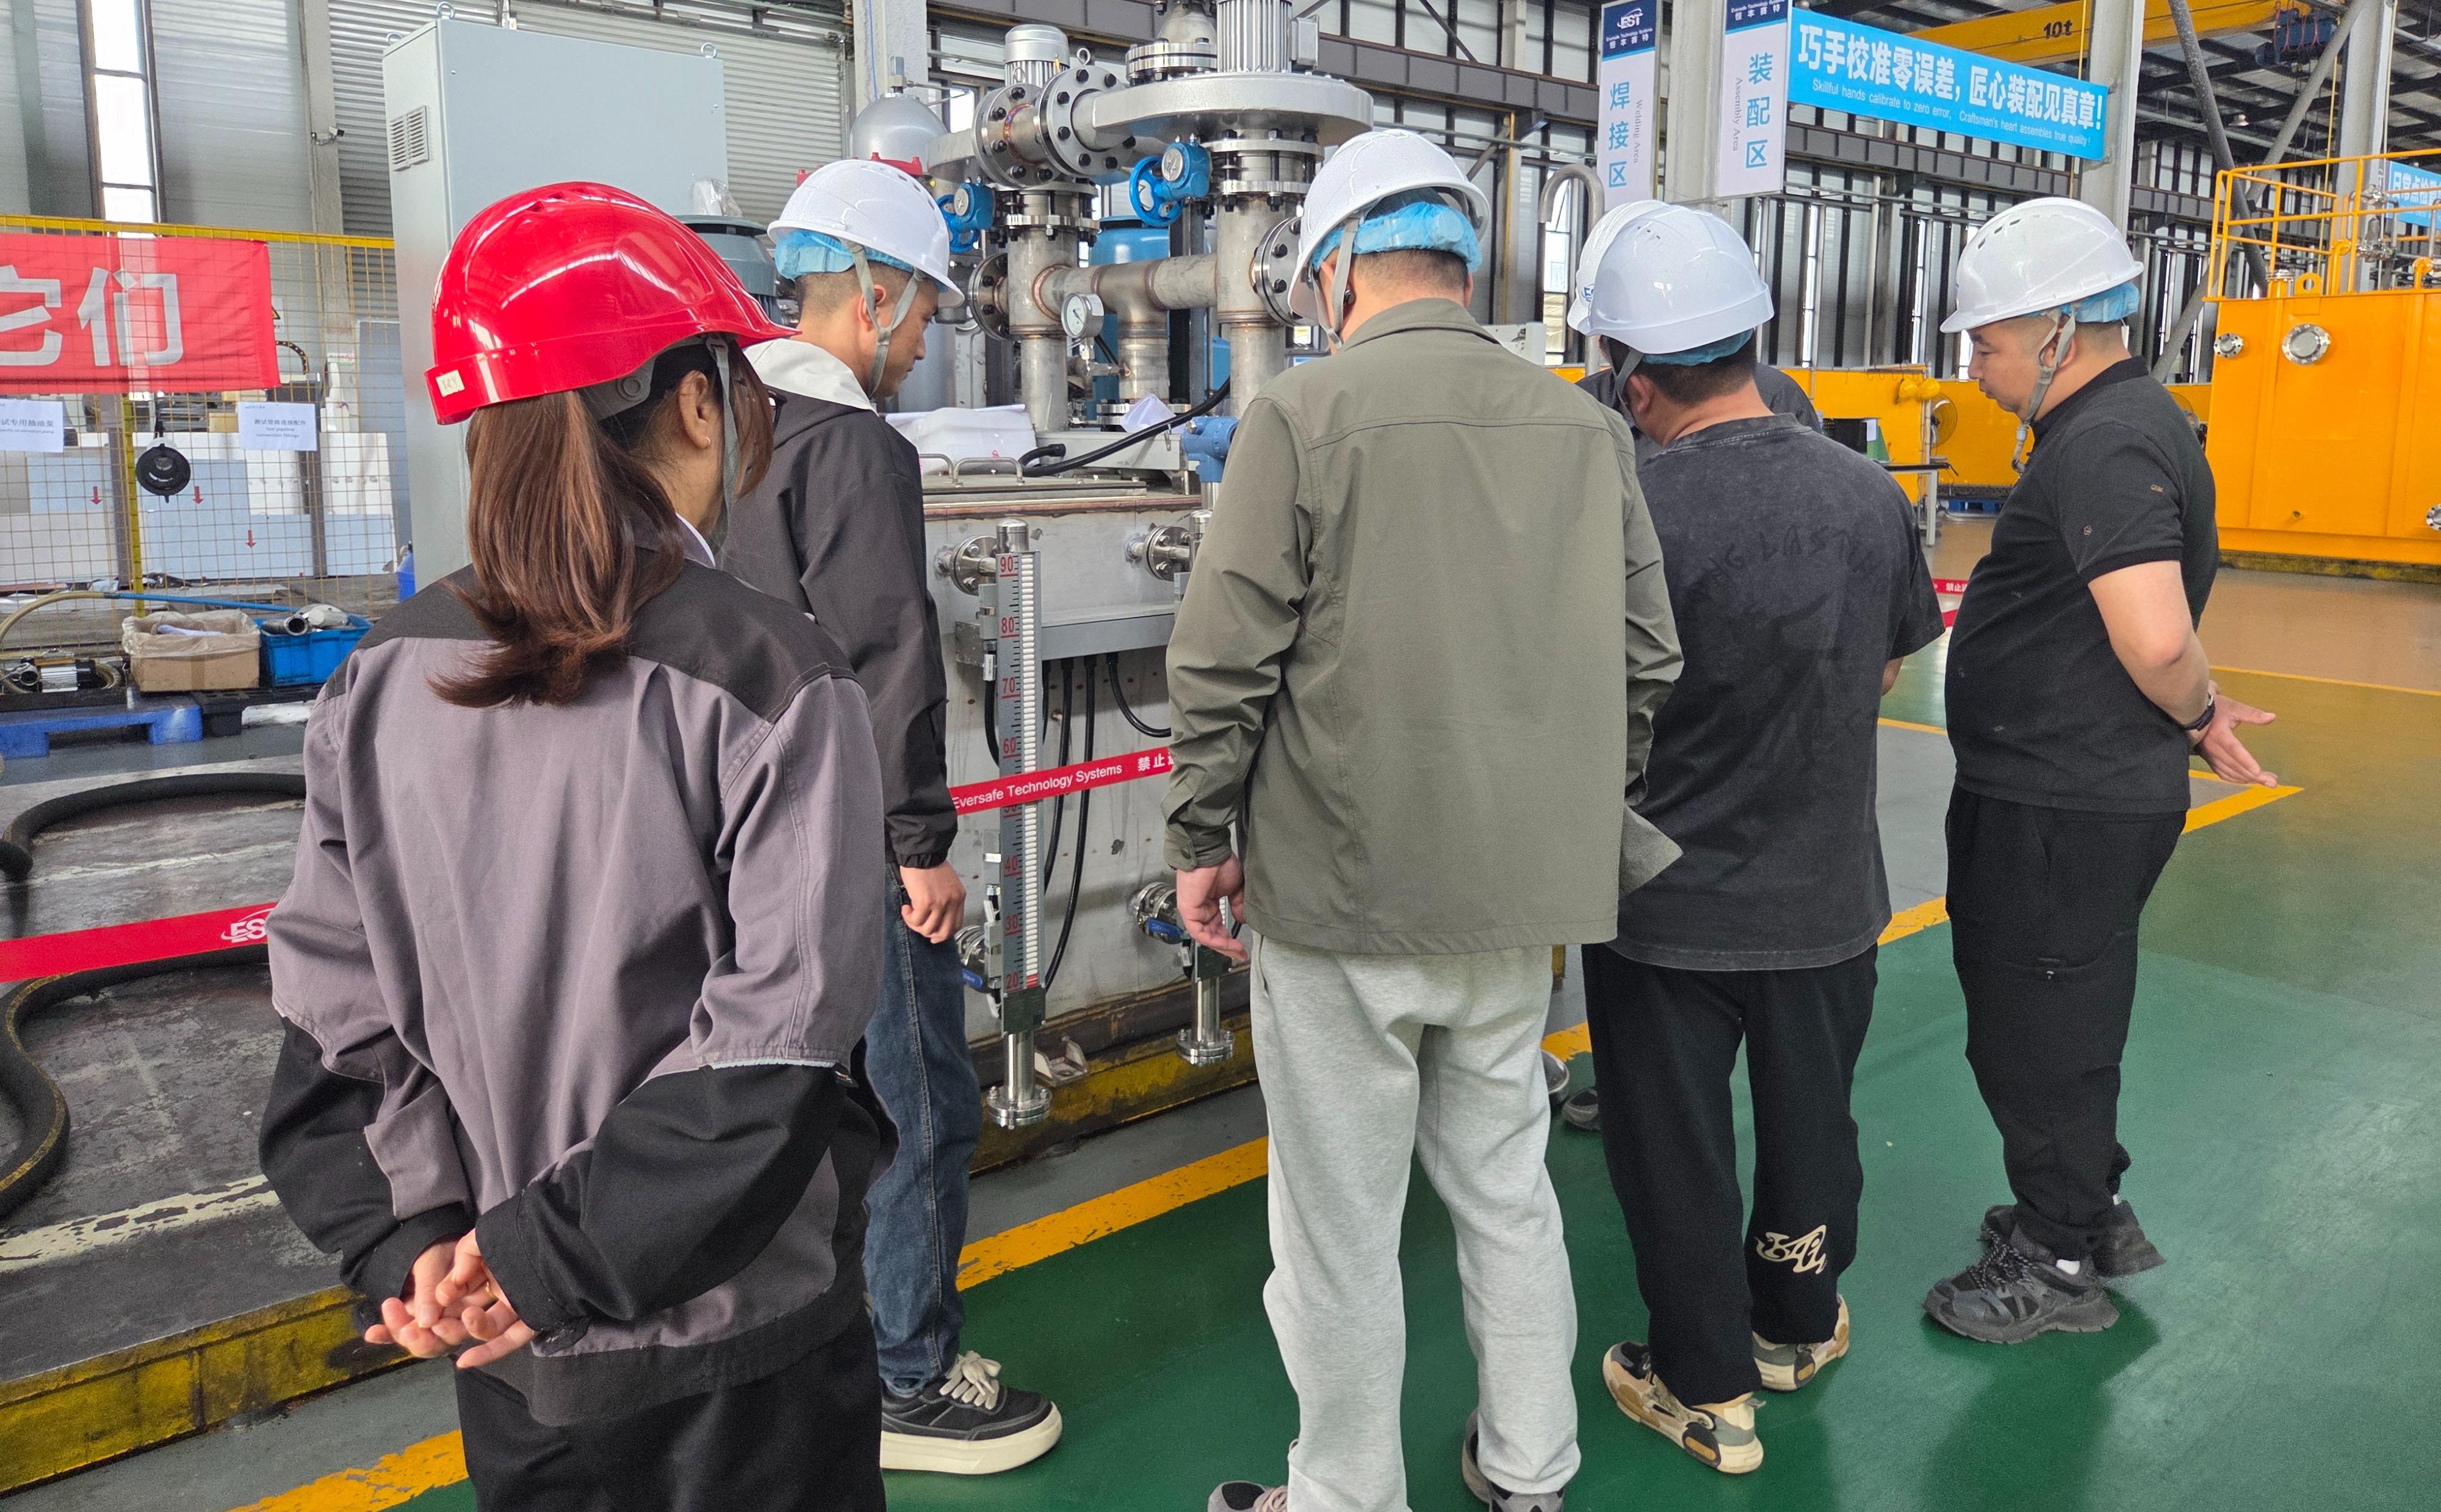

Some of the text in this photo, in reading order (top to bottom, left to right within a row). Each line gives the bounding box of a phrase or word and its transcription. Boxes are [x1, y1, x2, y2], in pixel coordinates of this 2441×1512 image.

[2044, 20, 2072, 39] 10t
[1632, 99, 1643, 139] Welding
[1732, 77, 1743, 152] Assembly Area
[1745, 52, 1773, 168] 装配区
[1812, 79, 1839, 95] Skillful
[1842, 85, 1866, 101] hands
[1869, 92, 1900, 108] calibrate
[1903, 99, 1911, 110] to
[1914, 103, 1930, 114] zero
[1960, 110, 1999, 128] Craftsman's
[2001, 119, 2017, 132] heart
[2019, 124, 2052, 139] assembles
[2054, 131, 2066, 142] true
[1609, 81, 1630, 188] 焊接区
[0, 419, 54, 427] 试专用抽油泵
[1000, 556, 1013, 572] 90
[1001, 617, 1015, 633] 80
[1002, 676, 1015, 694] 70
[1003, 737, 1016, 754] 60
[952, 765, 1122, 810] Eversafe Technology Systems
[1004, 855, 1018, 872] 40
[1006, 914, 1018, 931] 30
[1006, 972, 1018, 989] 20
